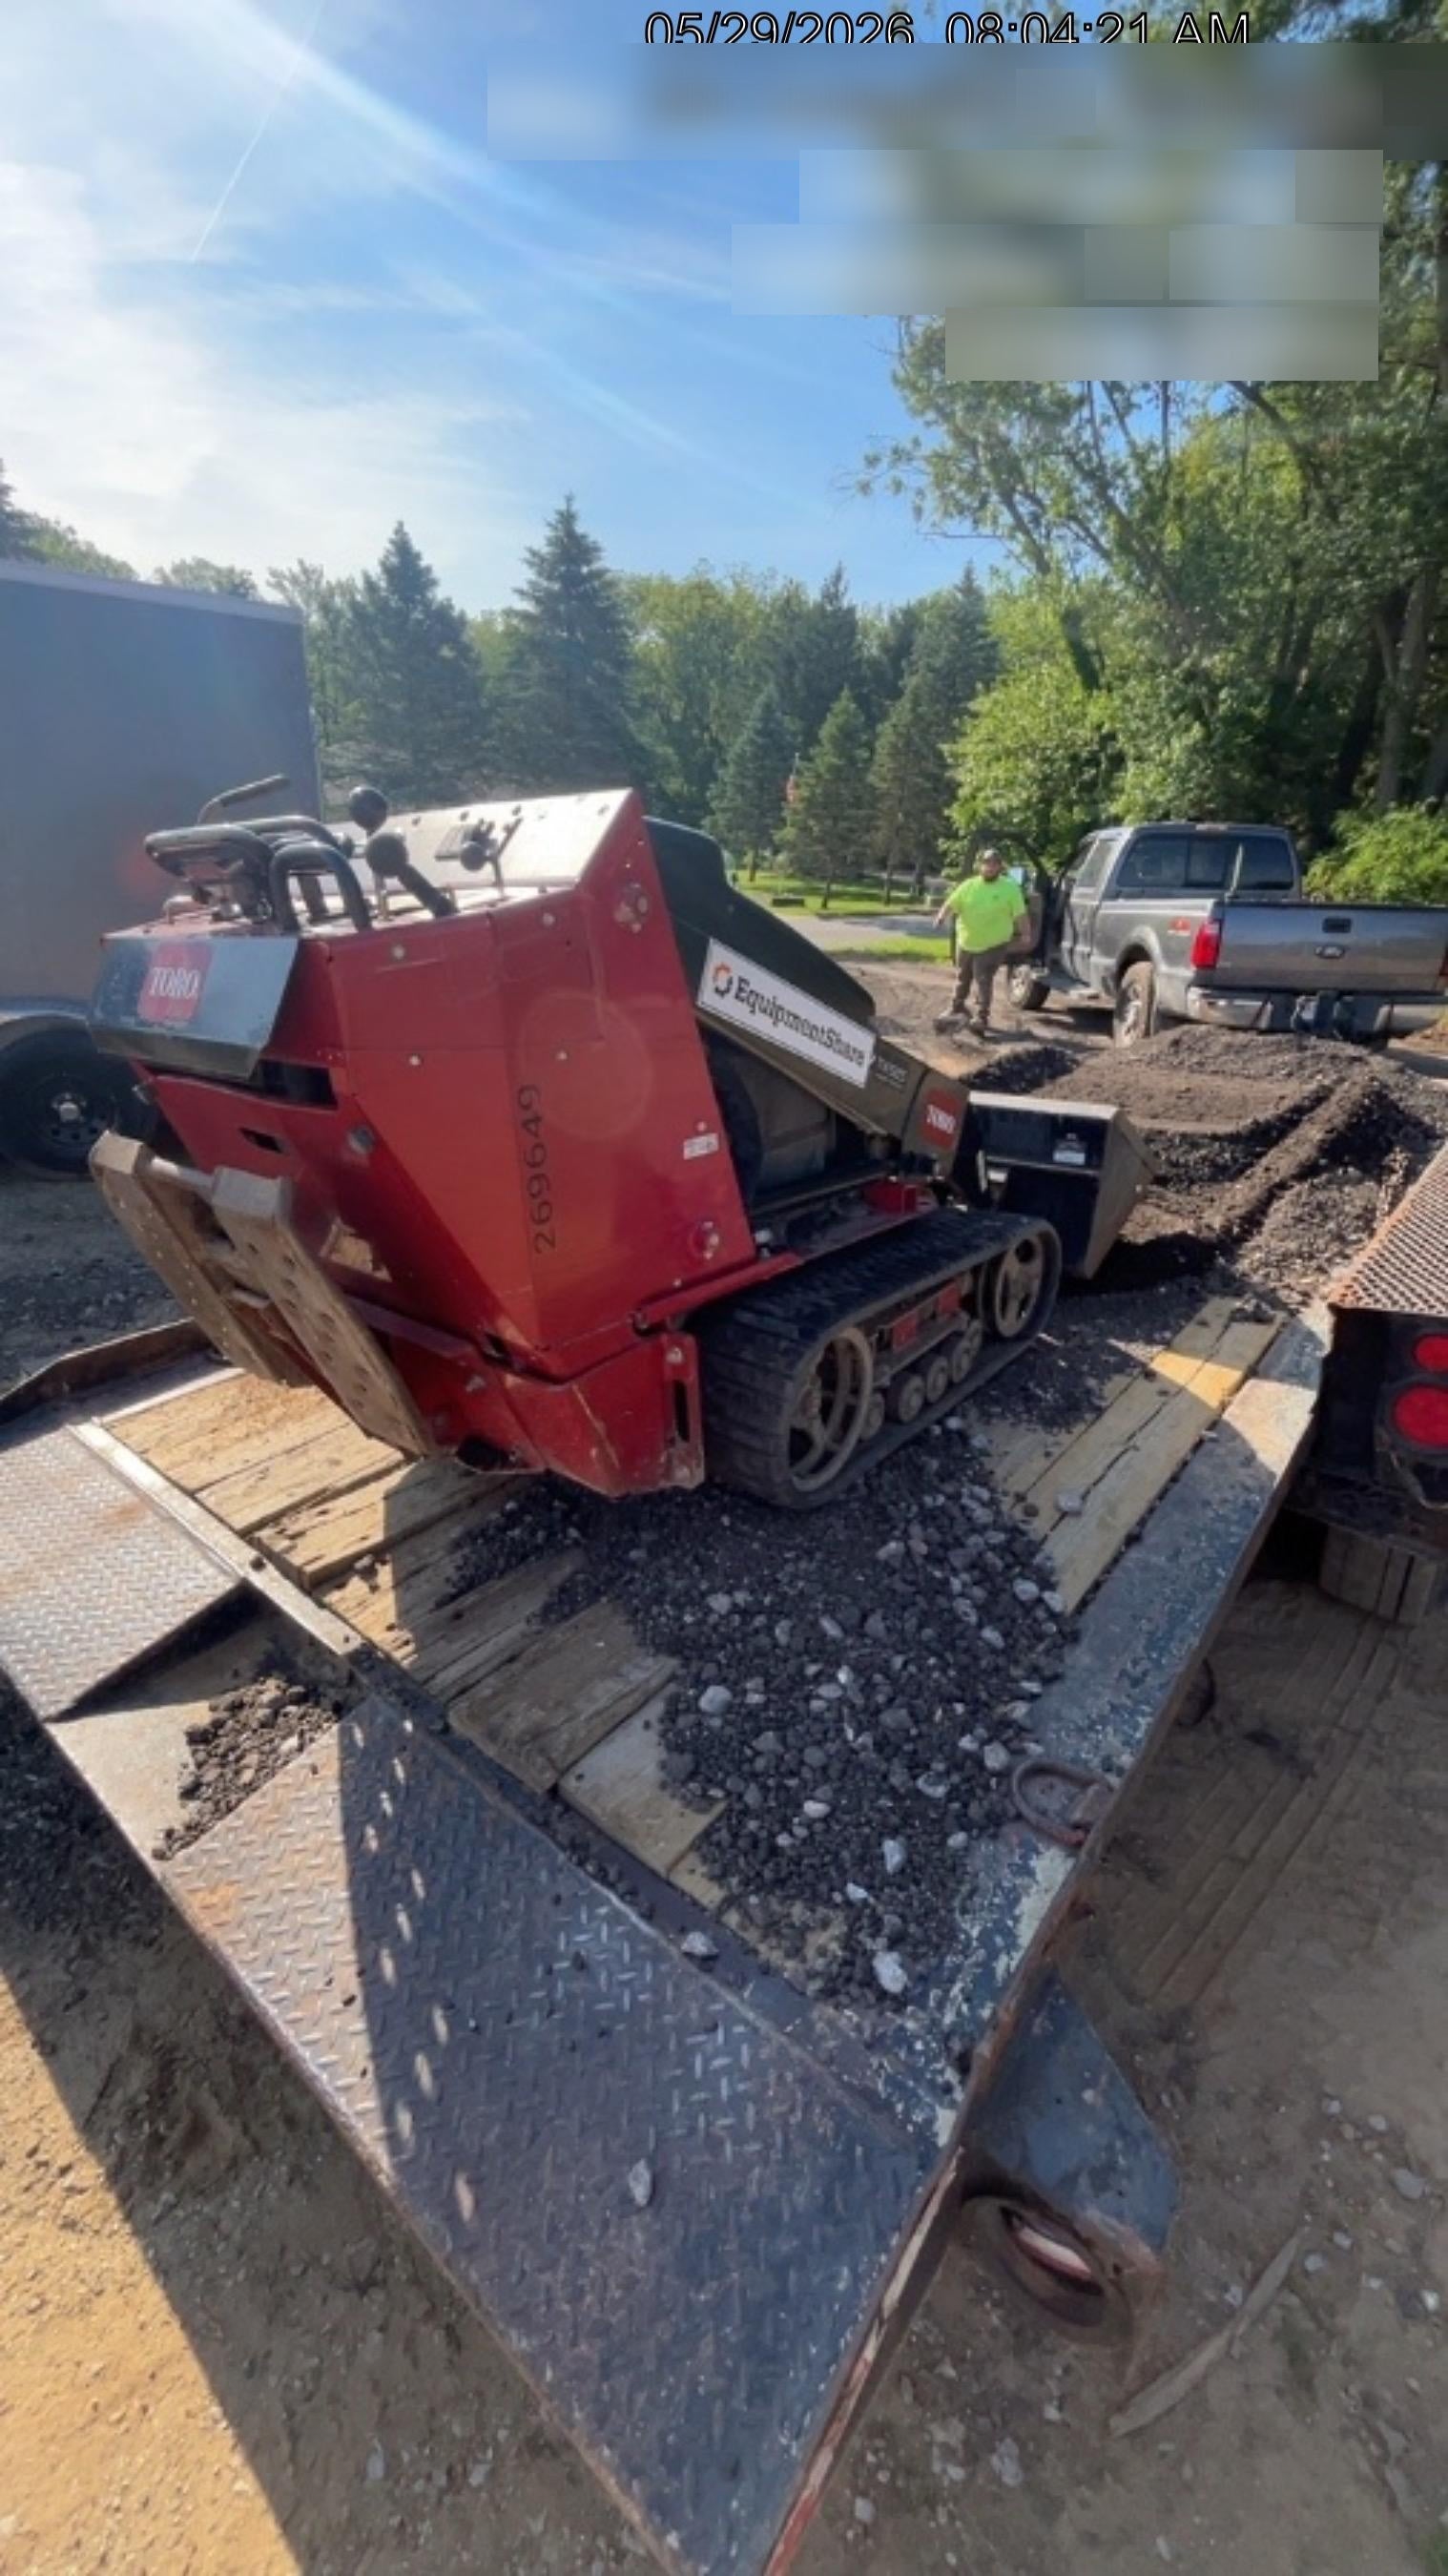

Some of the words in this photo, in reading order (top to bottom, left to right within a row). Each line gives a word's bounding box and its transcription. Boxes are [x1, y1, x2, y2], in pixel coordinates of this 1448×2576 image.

[149, 966, 200, 1000] TORO
[734, 975, 866, 1067] EquipmentShare
[518, 1084, 556, 1255] 269649
